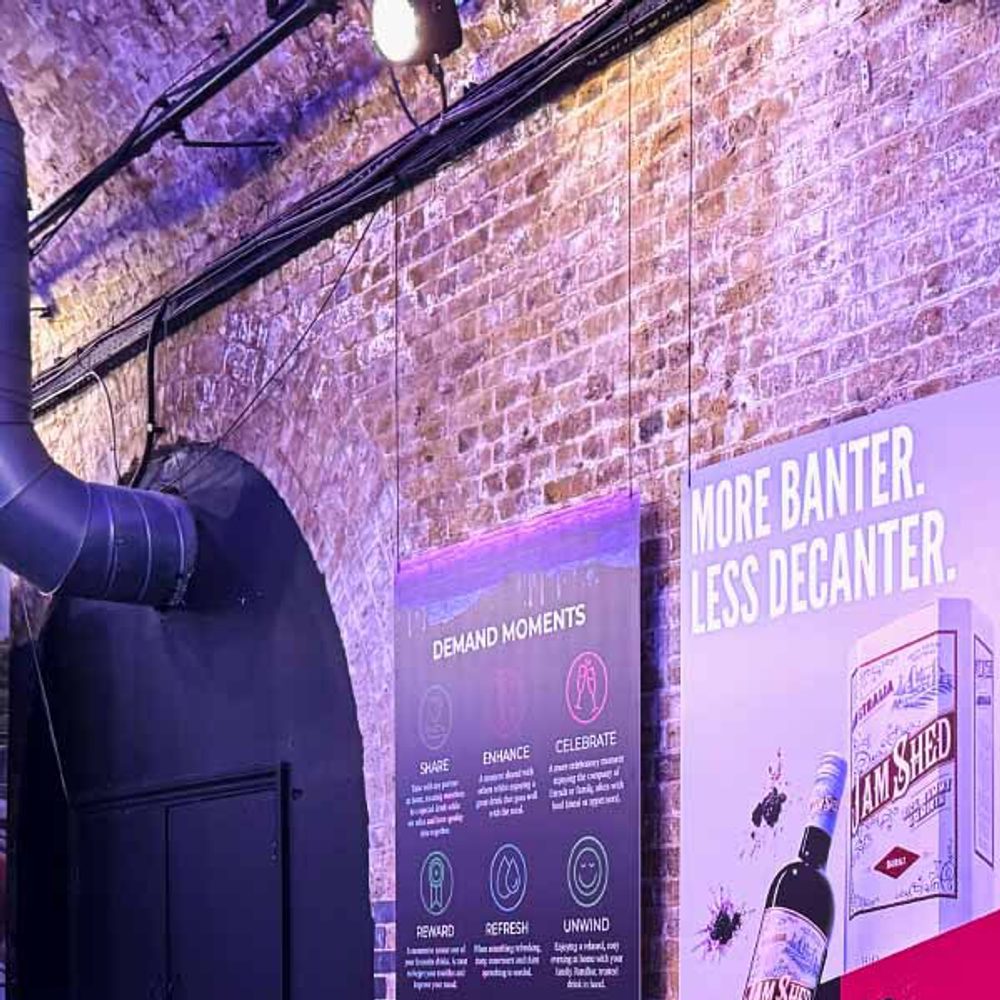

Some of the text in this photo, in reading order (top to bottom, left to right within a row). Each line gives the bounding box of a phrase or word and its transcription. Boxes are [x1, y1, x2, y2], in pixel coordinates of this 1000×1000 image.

[690, 425, 926, 556] MORE BANTER.
[690, 508, 957, 635] LESS DECANTER.
[432, 603, 587, 662] DEMAND MOMENTS
[555, 730, 618, 753] CELEBRATE
[483, 745, 531, 765] ENHANCE
[891, 718, 952, 800] SHED
[420, 758, 450, 775] SHARE
[416, 923, 455, 940] REWARD
[485, 920, 530, 936] REFRESH
[563, 916, 610, 933] UNWIND
